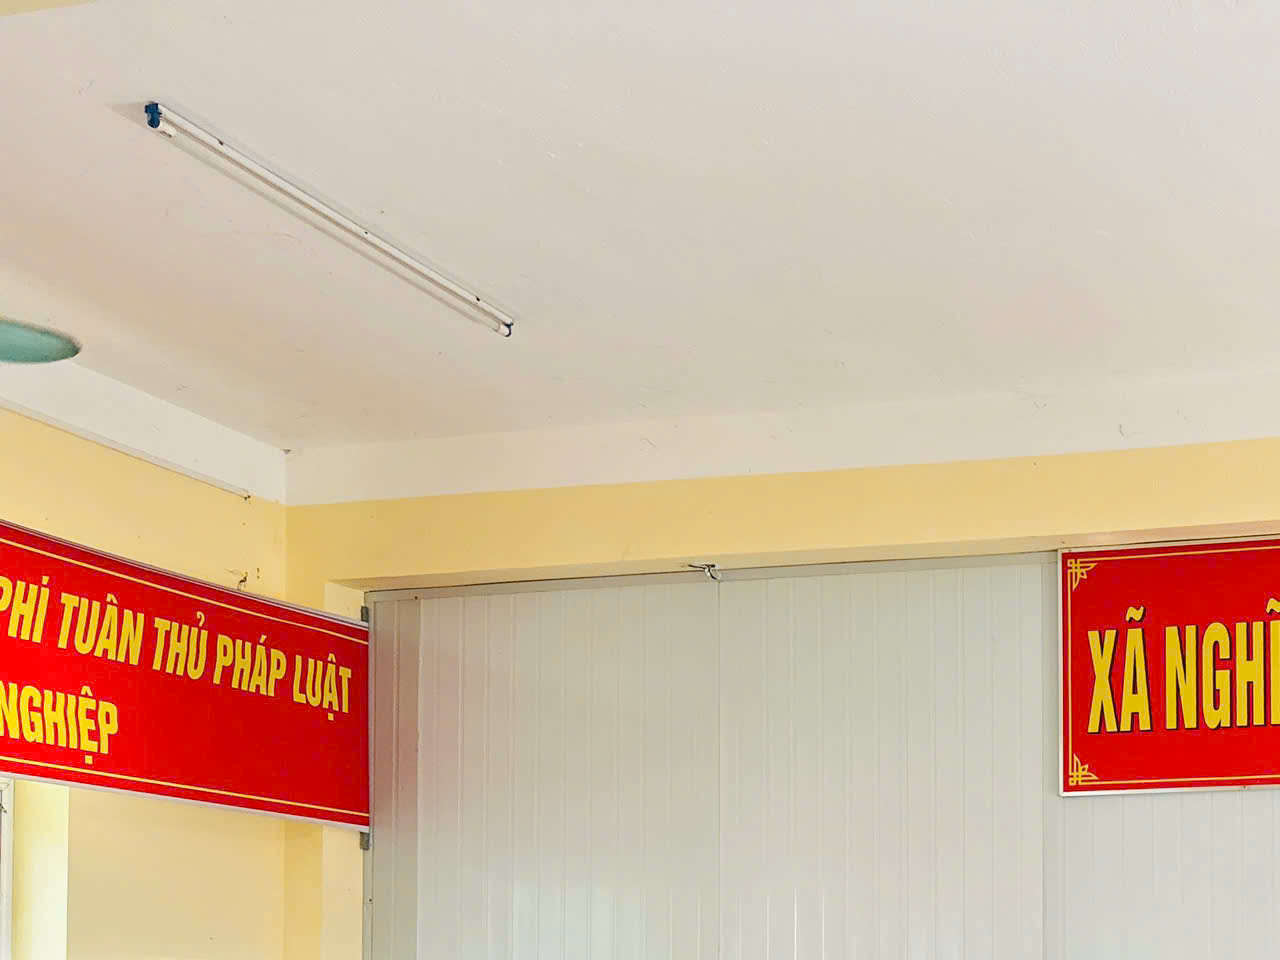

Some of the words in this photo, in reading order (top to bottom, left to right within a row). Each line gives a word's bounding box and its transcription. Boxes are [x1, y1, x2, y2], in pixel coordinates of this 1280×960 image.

[57, 592, 145, 665] TUÂN
[151, 611, 209, 680] THỦ
[213, 634, 287, 697] PHÁP
[292, 652, 352, 721] LUẬT
[1087, 604, 1152, 734] XÃ
[0, 680, 119, 765] NGHIỆP
